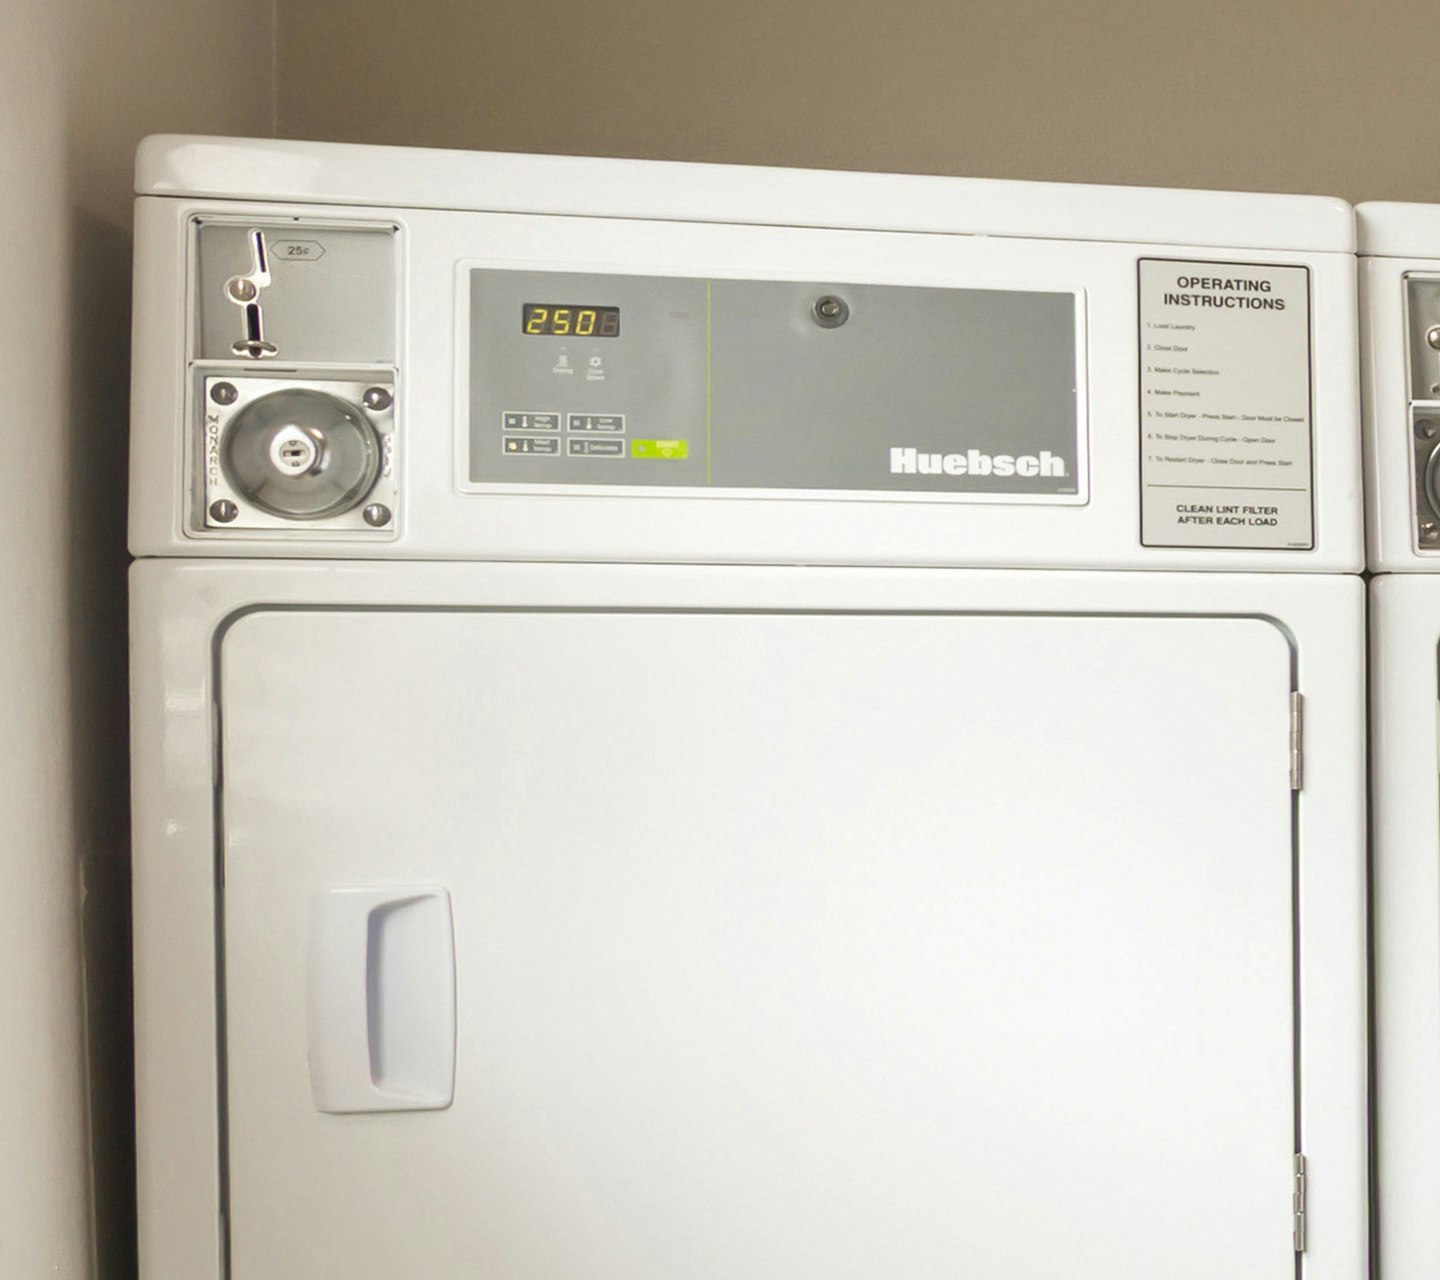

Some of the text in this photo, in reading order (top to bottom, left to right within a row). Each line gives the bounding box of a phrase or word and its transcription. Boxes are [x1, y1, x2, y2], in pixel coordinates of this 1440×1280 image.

[1177, 276, 1271, 292] OPERATING
[1164, 294, 1285, 310] INSTRUCTIONS
[526, 308, 596, 335] 250
[208, 414, 219, 486] MONARCH
[890, 447, 1065, 477] Huebsch
[1176, 504, 1278, 515] CLEAN LINT FILTER
[1178, 516, 1278, 526] AFTER EACH LOAD
